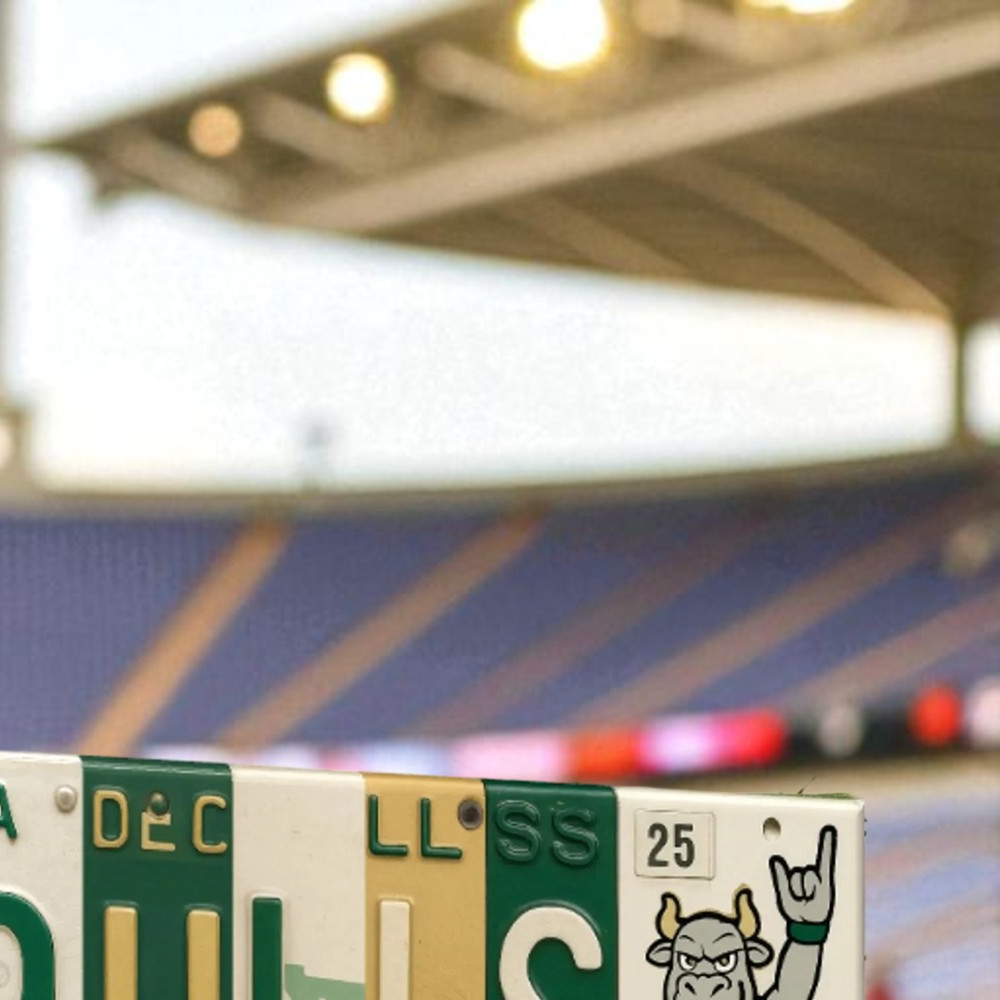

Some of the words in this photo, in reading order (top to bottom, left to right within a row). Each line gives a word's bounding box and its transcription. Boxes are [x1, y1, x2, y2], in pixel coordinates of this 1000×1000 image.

[91, 788, 228, 854] DEC
[368, 794, 463, 859] LL
[494, 799, 599, 866] SS
[646, 823, 696, 868] 25
